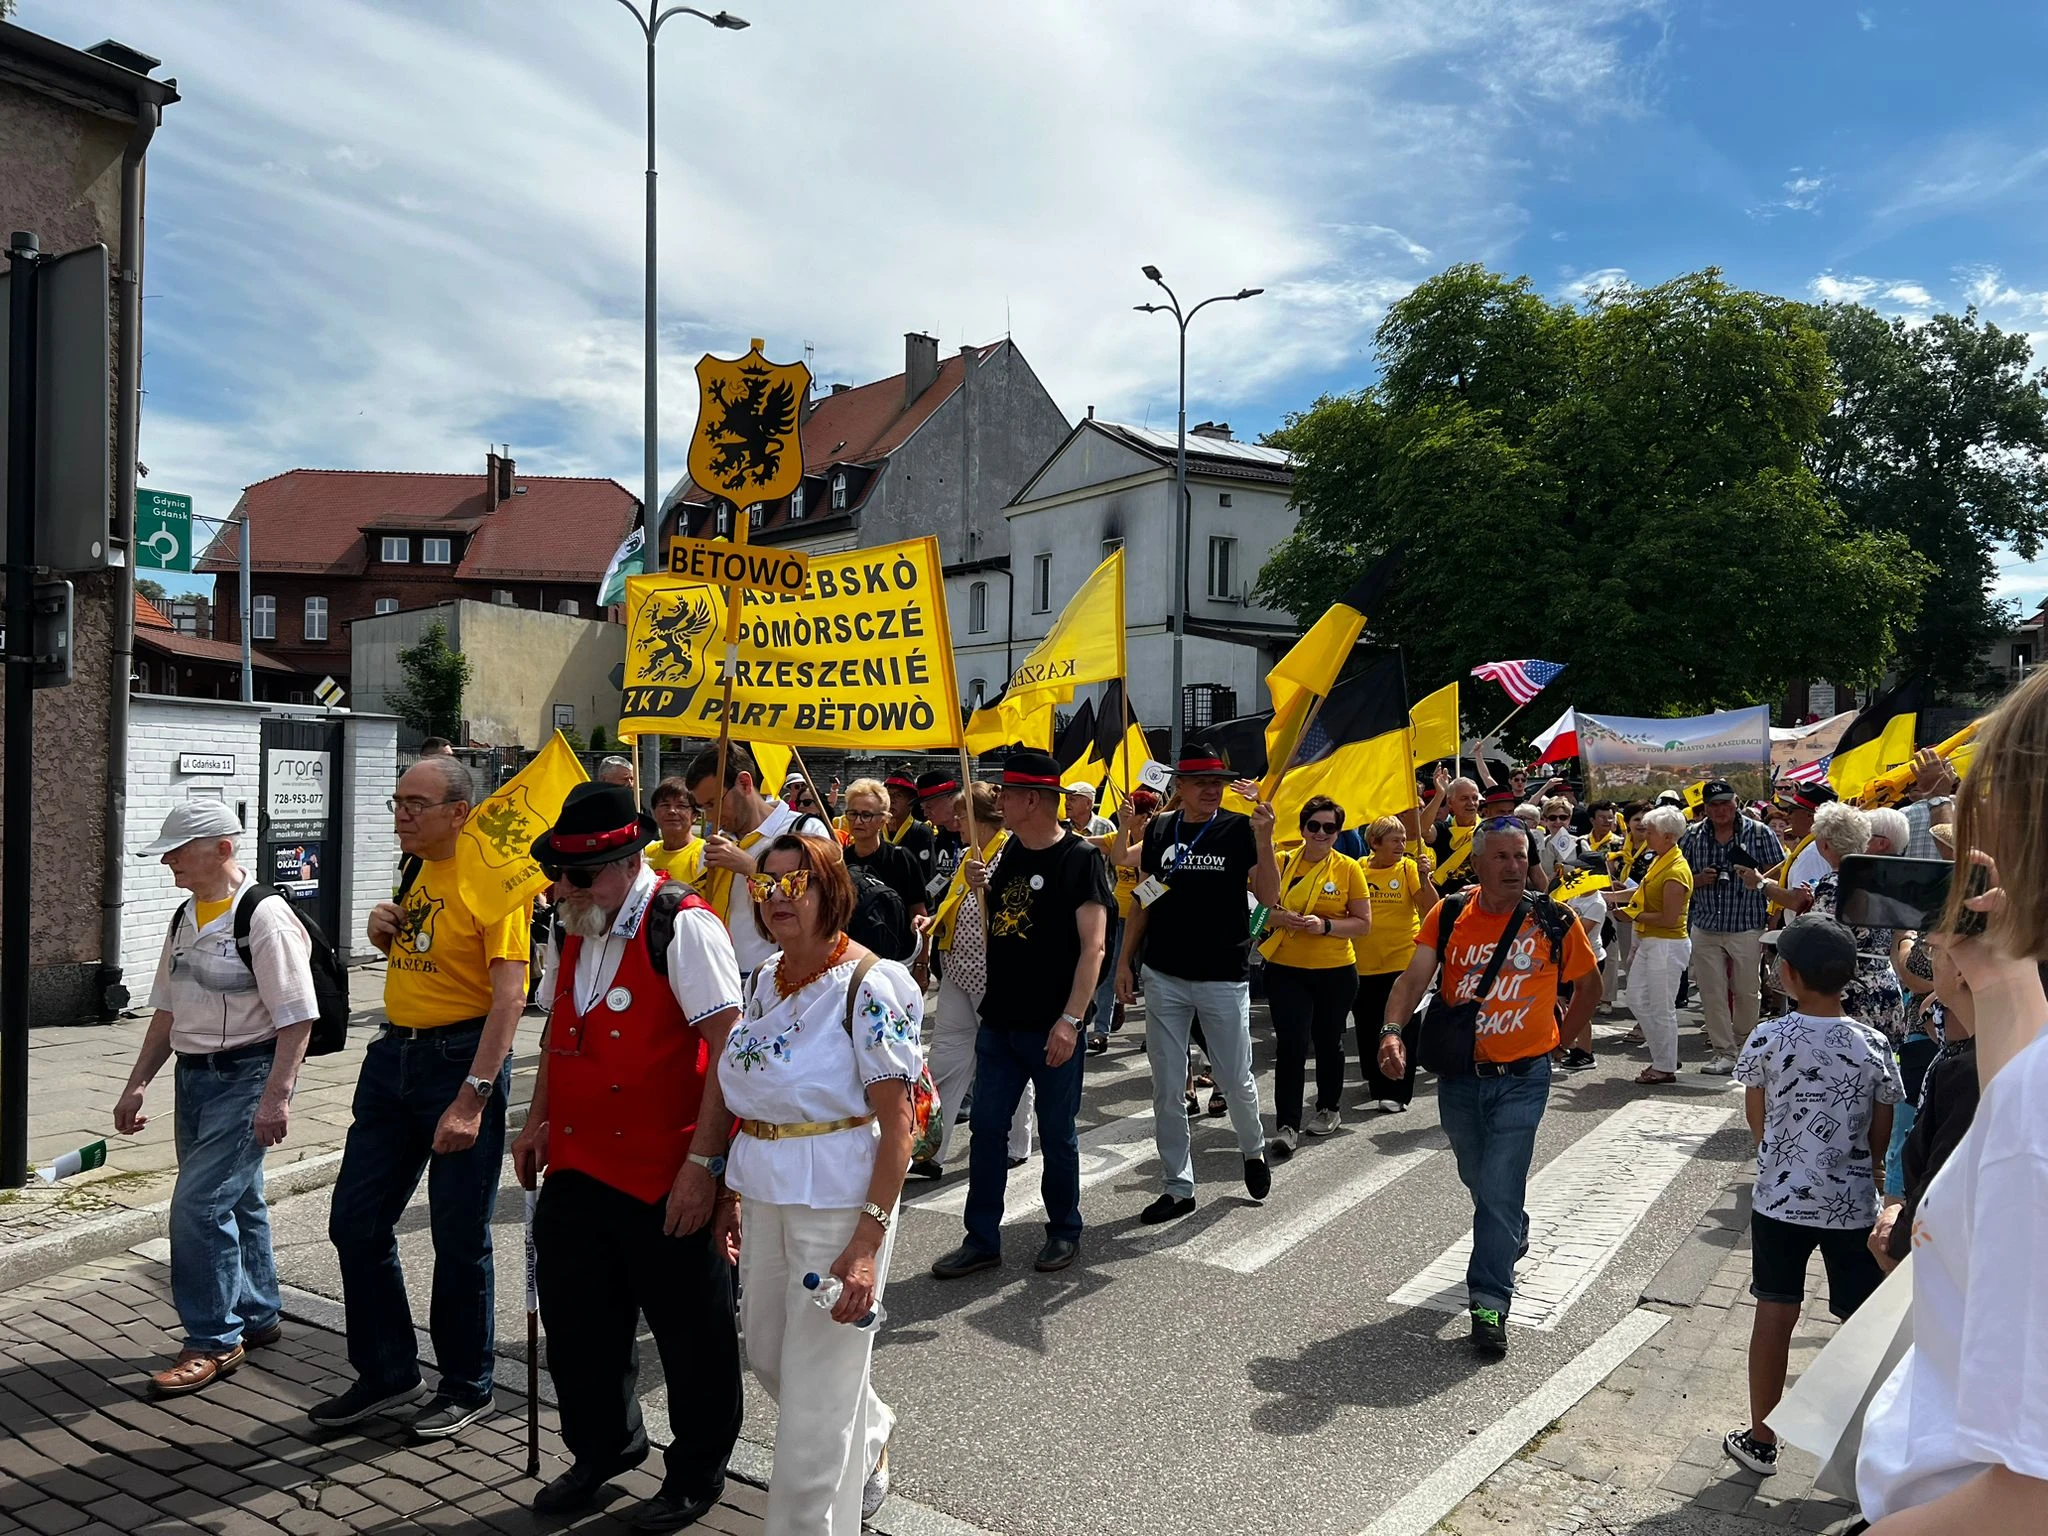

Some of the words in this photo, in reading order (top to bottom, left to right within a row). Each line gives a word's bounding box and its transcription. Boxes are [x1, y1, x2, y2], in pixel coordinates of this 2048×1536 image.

[153, 496, 186, 508] Gdynia
[153, 507, 188, 520] Gdańsk
[670, 543, 805, 590] BËTOWÒ
[714, 648, 930, 688] ZRZESZENIÉ
[623, 690, 676, 713] ZKP
[698, 698, 788, 728] PART
[793, 694, 936, 732] BËTOWÒ
[1676, 744, 1704, 753] MIASTO
[192, 759, 221, 769] Gdańska
[222, 761, 231, 769] 11
[274, 794, 323, 804] 728-953-077
[1451, 946, 1457, 966] I
[1460, 943, 1499, 966] JUS
[1506, 937, 1536, 960] DO
